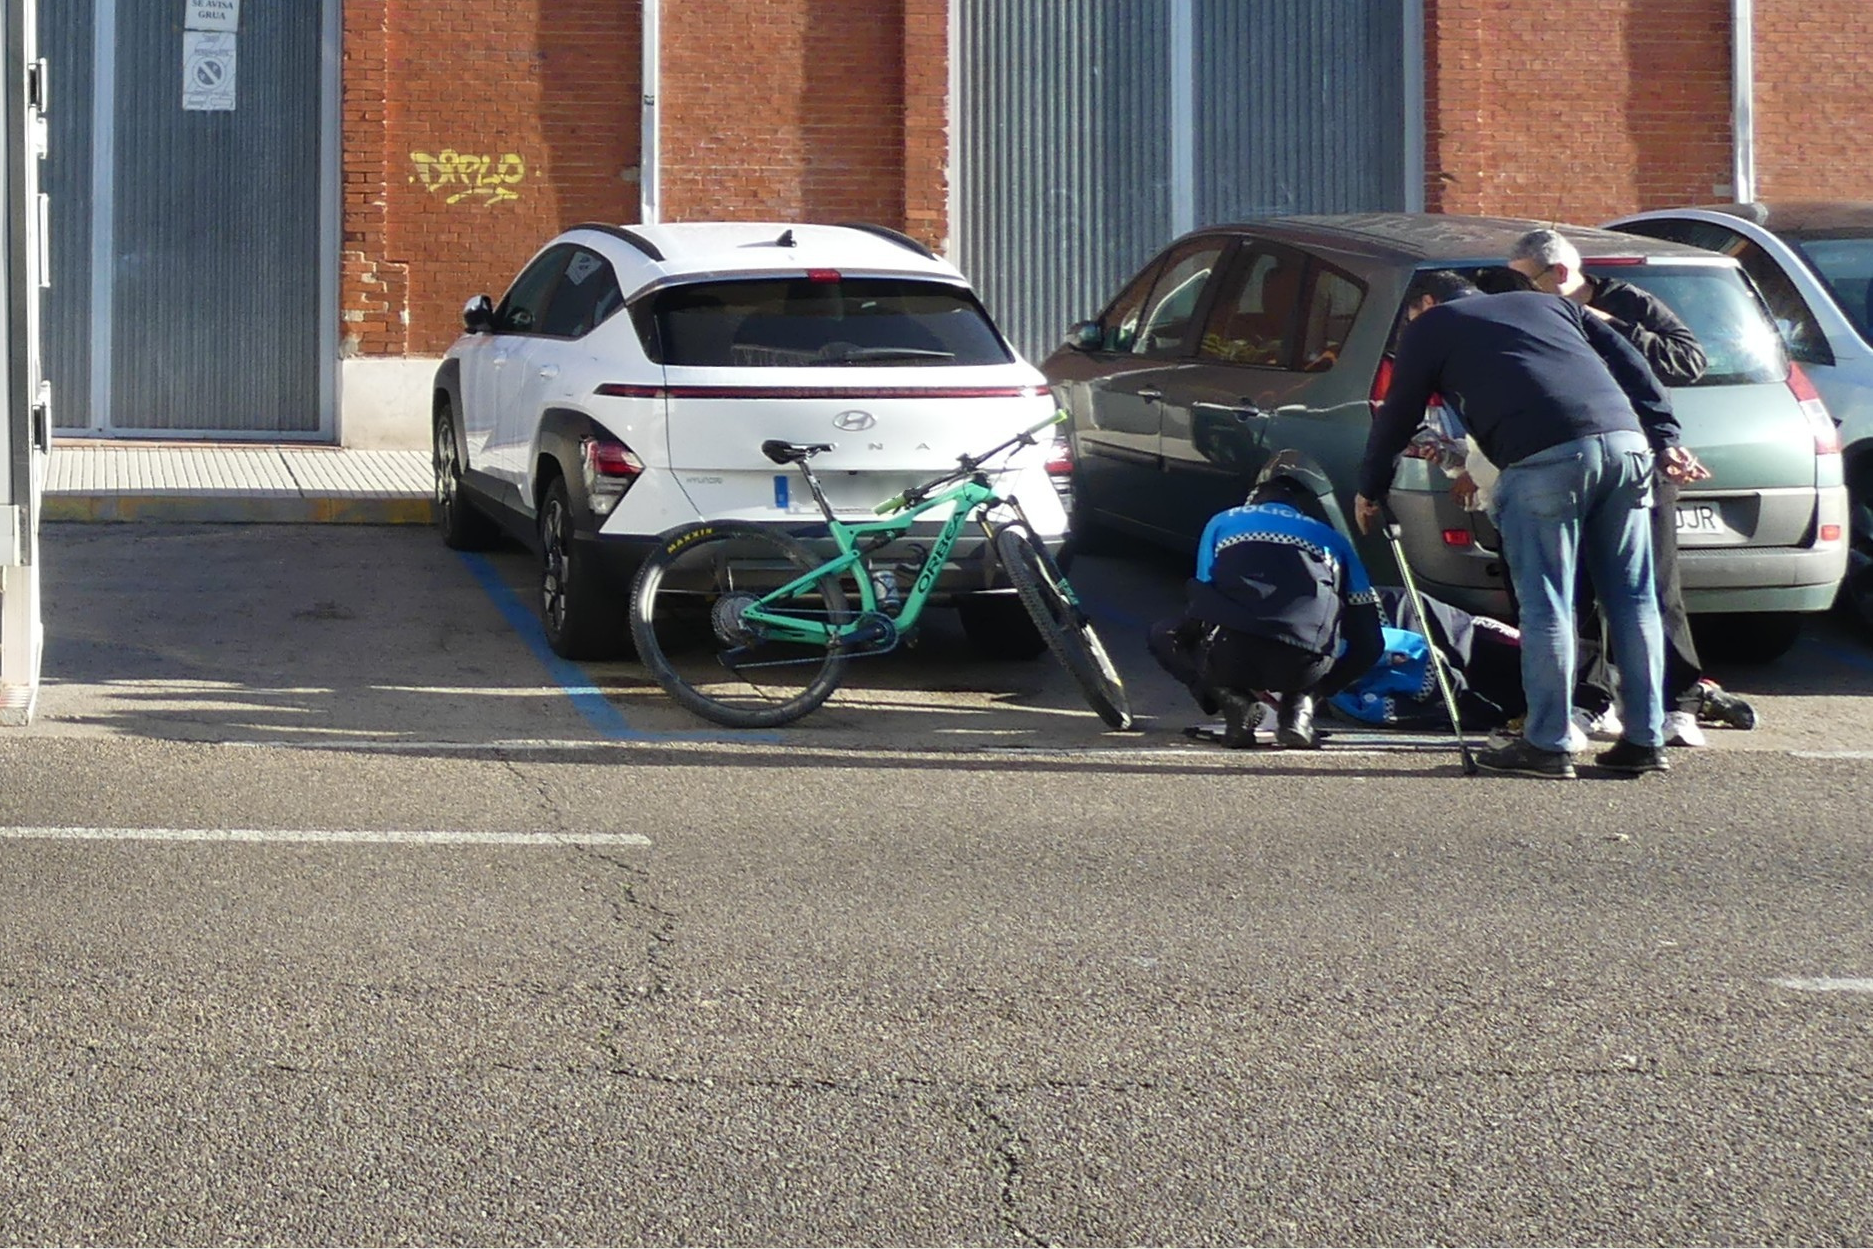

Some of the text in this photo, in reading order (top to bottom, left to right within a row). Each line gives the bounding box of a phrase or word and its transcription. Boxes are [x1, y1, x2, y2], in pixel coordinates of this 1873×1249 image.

[192, 0, 234, 10] SE AVISA
[197, 11, 226, 21] GRUA
[917, 511, 965, 594] ORBEA
